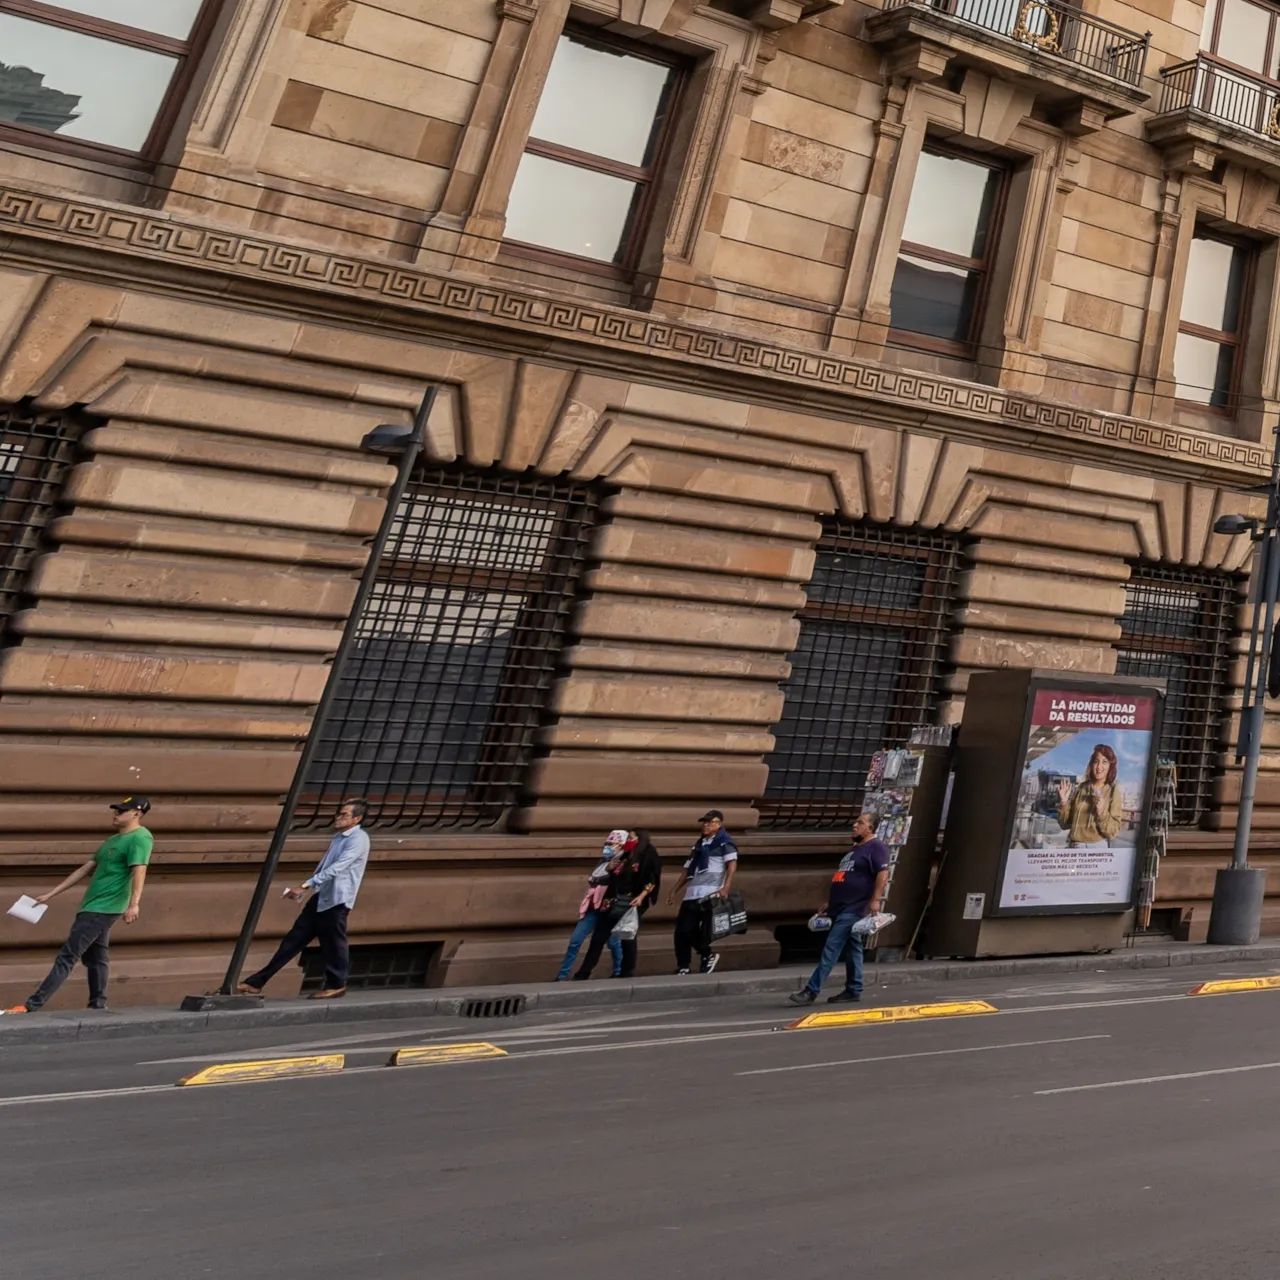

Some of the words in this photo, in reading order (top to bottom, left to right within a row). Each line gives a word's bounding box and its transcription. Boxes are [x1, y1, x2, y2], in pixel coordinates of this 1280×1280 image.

[1051, 699, 1067, 710] LA
[1069, 701, 1136, 713] HONESTIDAD
[1049, 711, 1065, 721] DA
[1067, 712, 1135, 725] RESULTADOS
